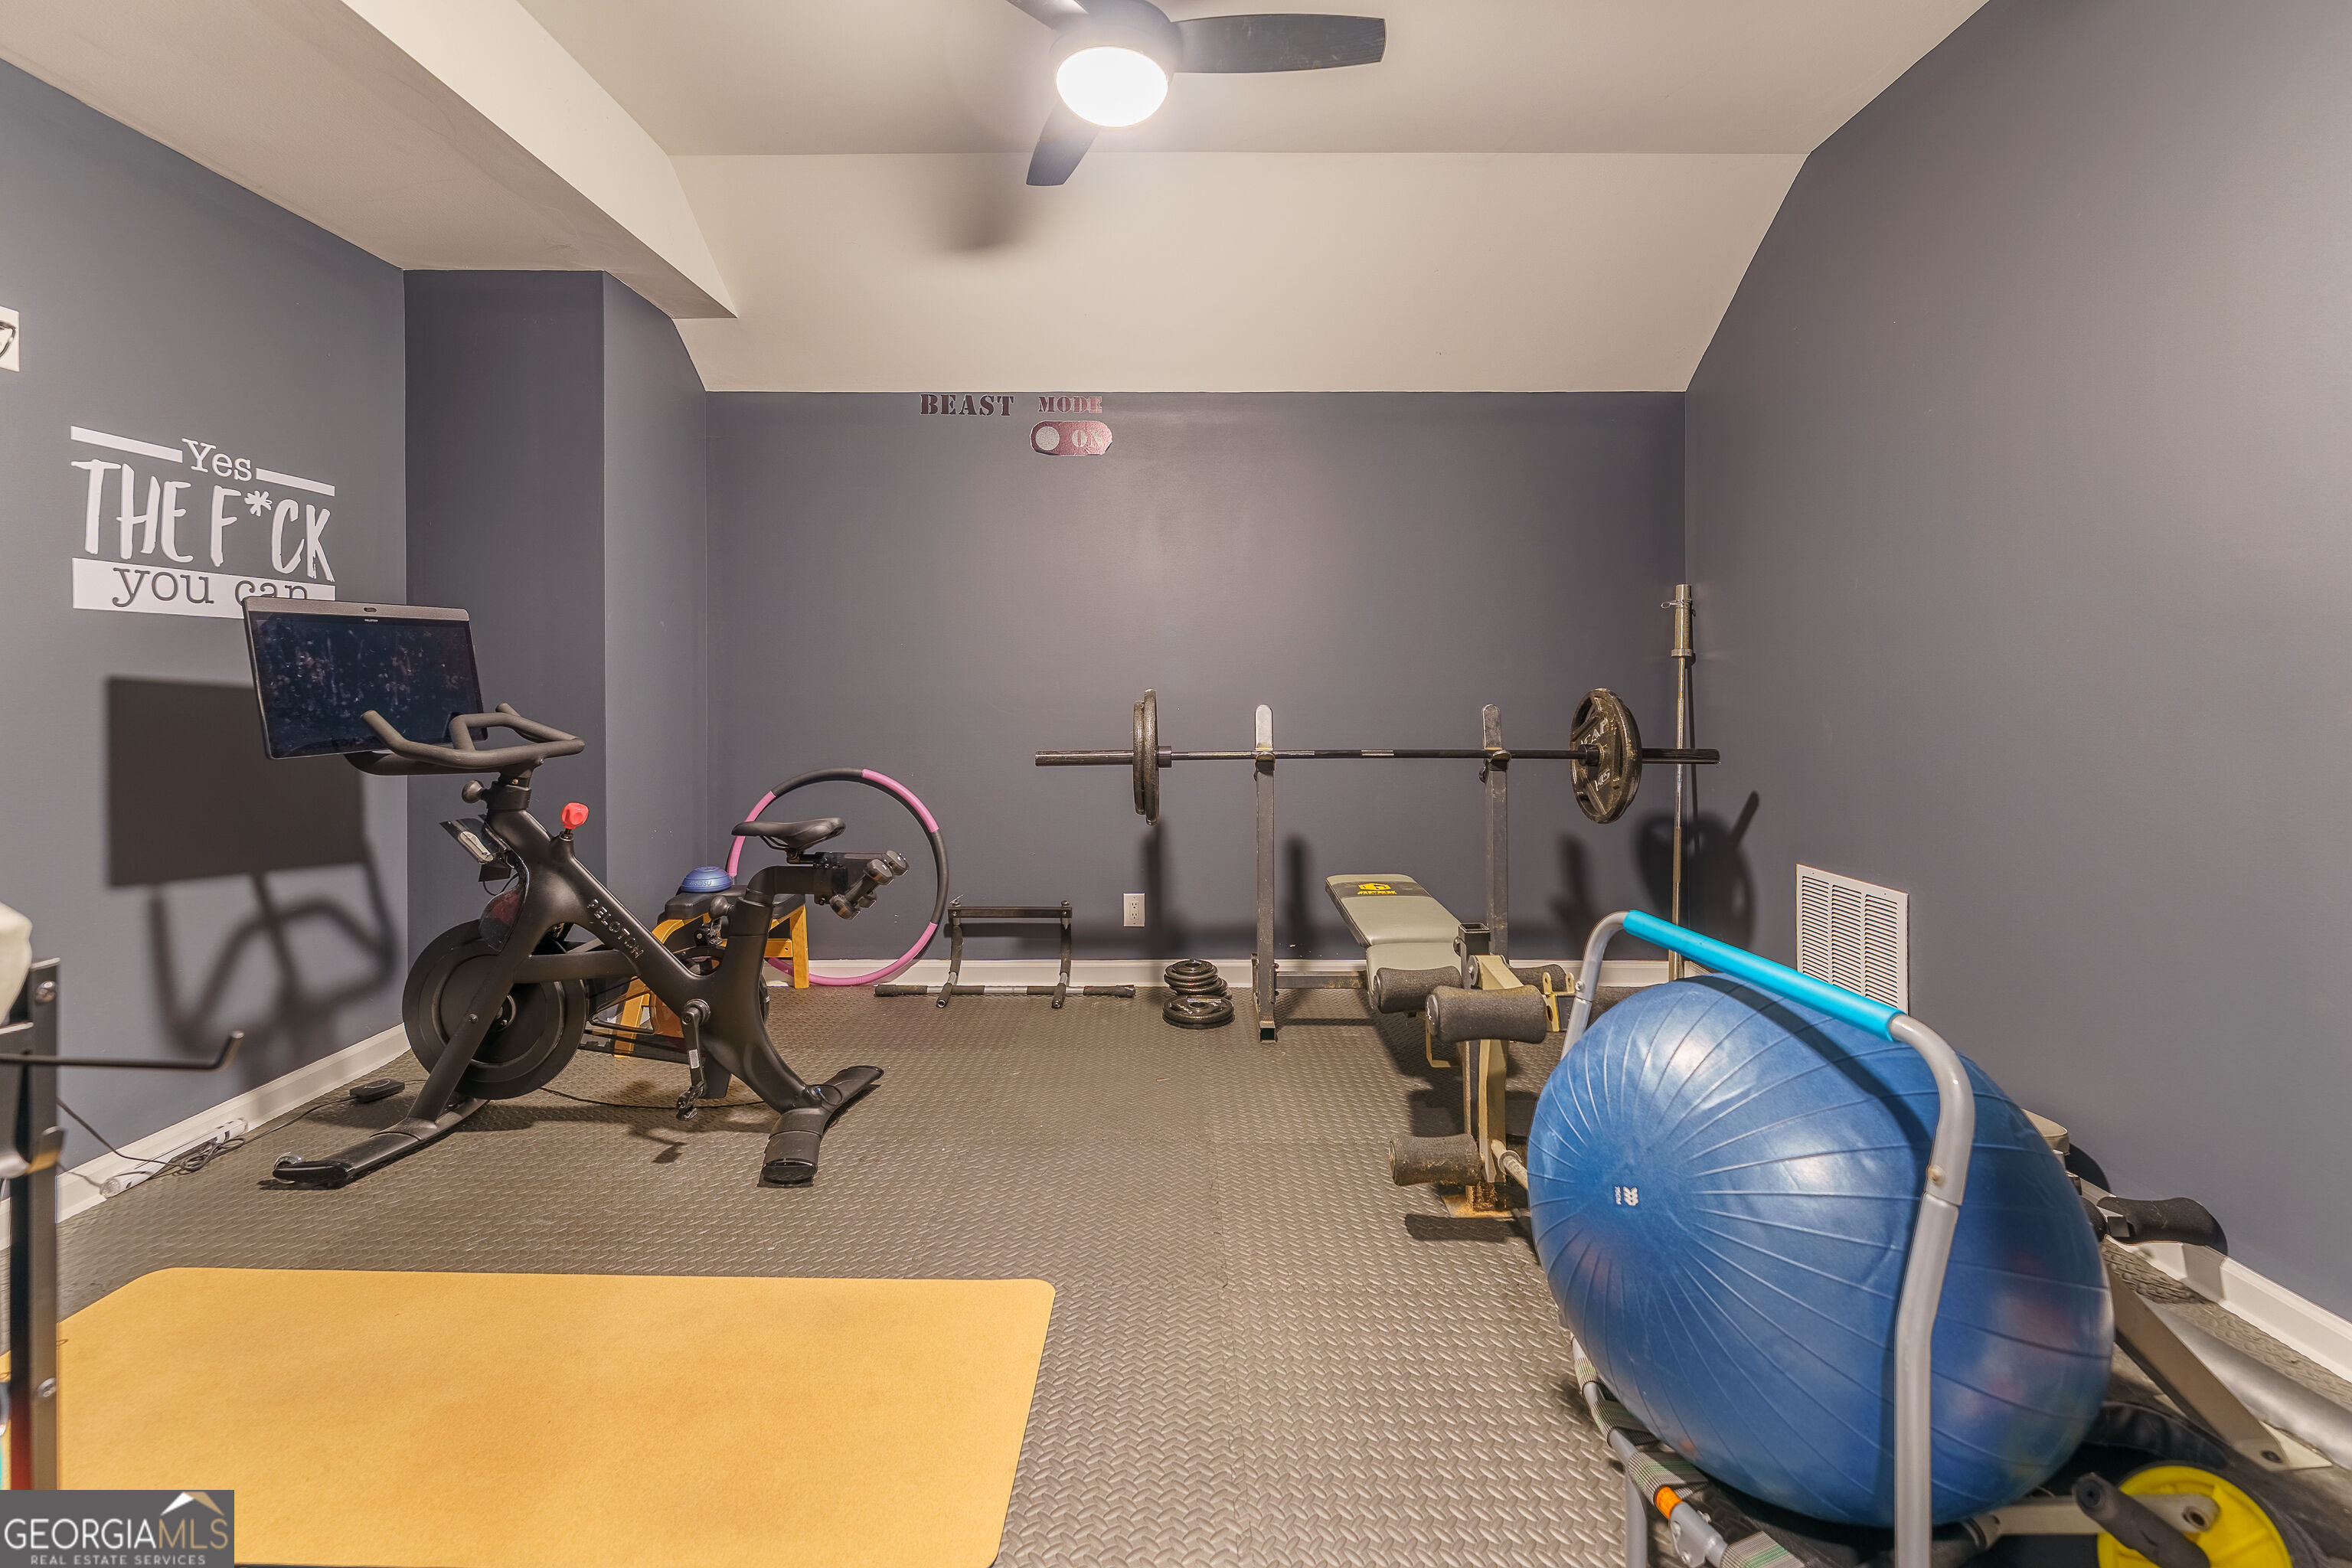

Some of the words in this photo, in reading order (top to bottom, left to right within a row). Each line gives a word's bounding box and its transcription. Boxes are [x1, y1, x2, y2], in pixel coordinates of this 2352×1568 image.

[919, 394, 1014, 416] BEAST
[1037, 395, 1103, 413] MODE
[181, 437, 253, 482] Yes
[1072, 429, 1104, 448] ON
[70, 459, 194, 563] THE
[112, 567, 214, 607] you
[586, 898, 644, 959] PELOTON
